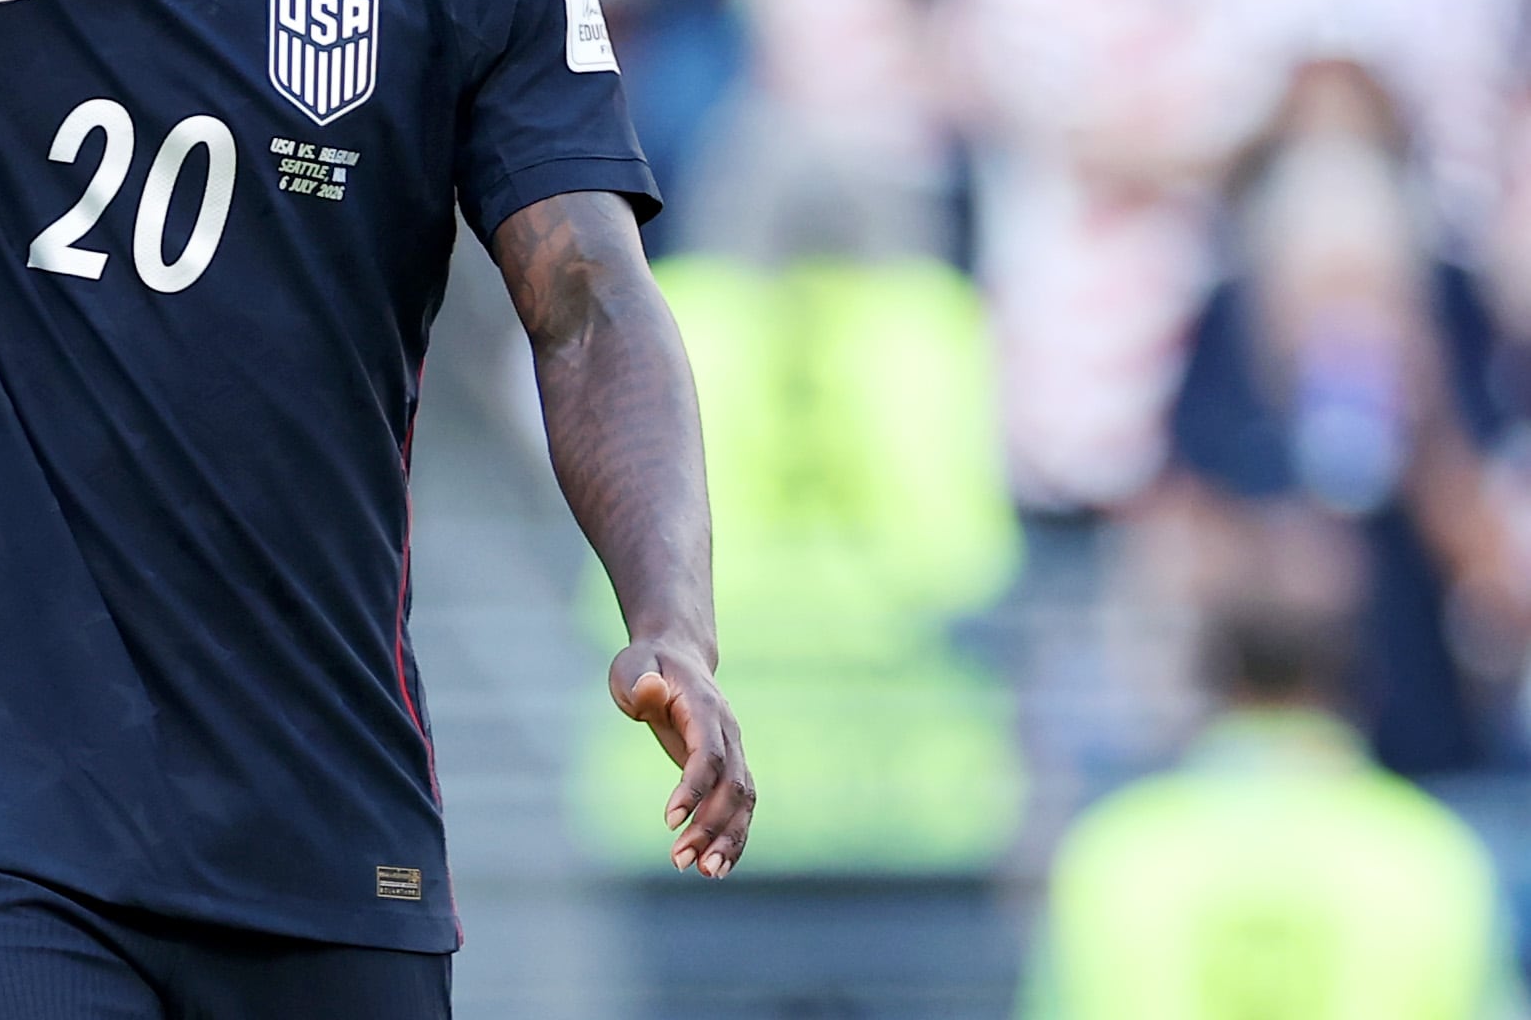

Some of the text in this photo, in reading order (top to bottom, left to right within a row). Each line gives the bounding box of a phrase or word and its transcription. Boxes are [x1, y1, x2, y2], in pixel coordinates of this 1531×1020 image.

[270, 138, 296, 156] USA
[278, 158, 329, 182] SEATTLE,
[27, 98, 237, 293] 20
[279, 175, 345, 201] 6 JULY 2026
